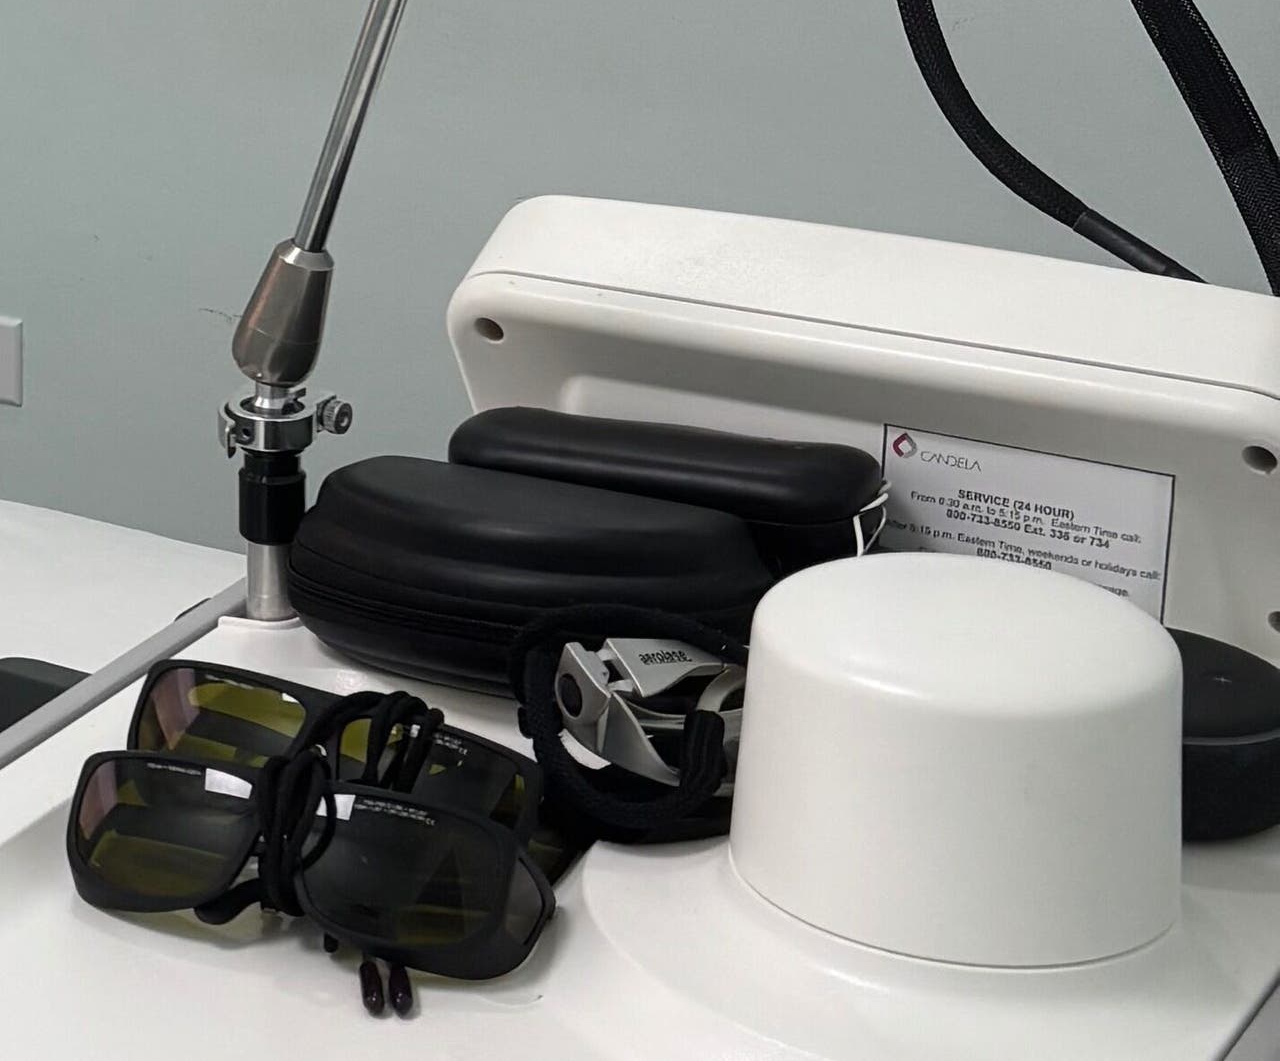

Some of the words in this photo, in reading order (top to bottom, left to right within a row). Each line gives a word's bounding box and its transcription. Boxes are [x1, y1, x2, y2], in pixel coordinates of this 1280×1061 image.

[920, 450, 982, 472] CANDELA
[911, 491, 936, 504] From
[1051, 518, 1091, 534] Eastern
[1093, 526, 1118, 539] Time
[958, 489, 1010, 508] SERVICE
[1013, 500, 1031, 512] (24
[1034, 503, 1075, 521] HOUR)
[957, 533, 996, 549] Eastern
[1028, 547, 1079, 565] weekends
[1081, 559, 1092, 567] or
[1095, 559, 1137, 578] holidays
[1073, 535, 1087, 544] or
